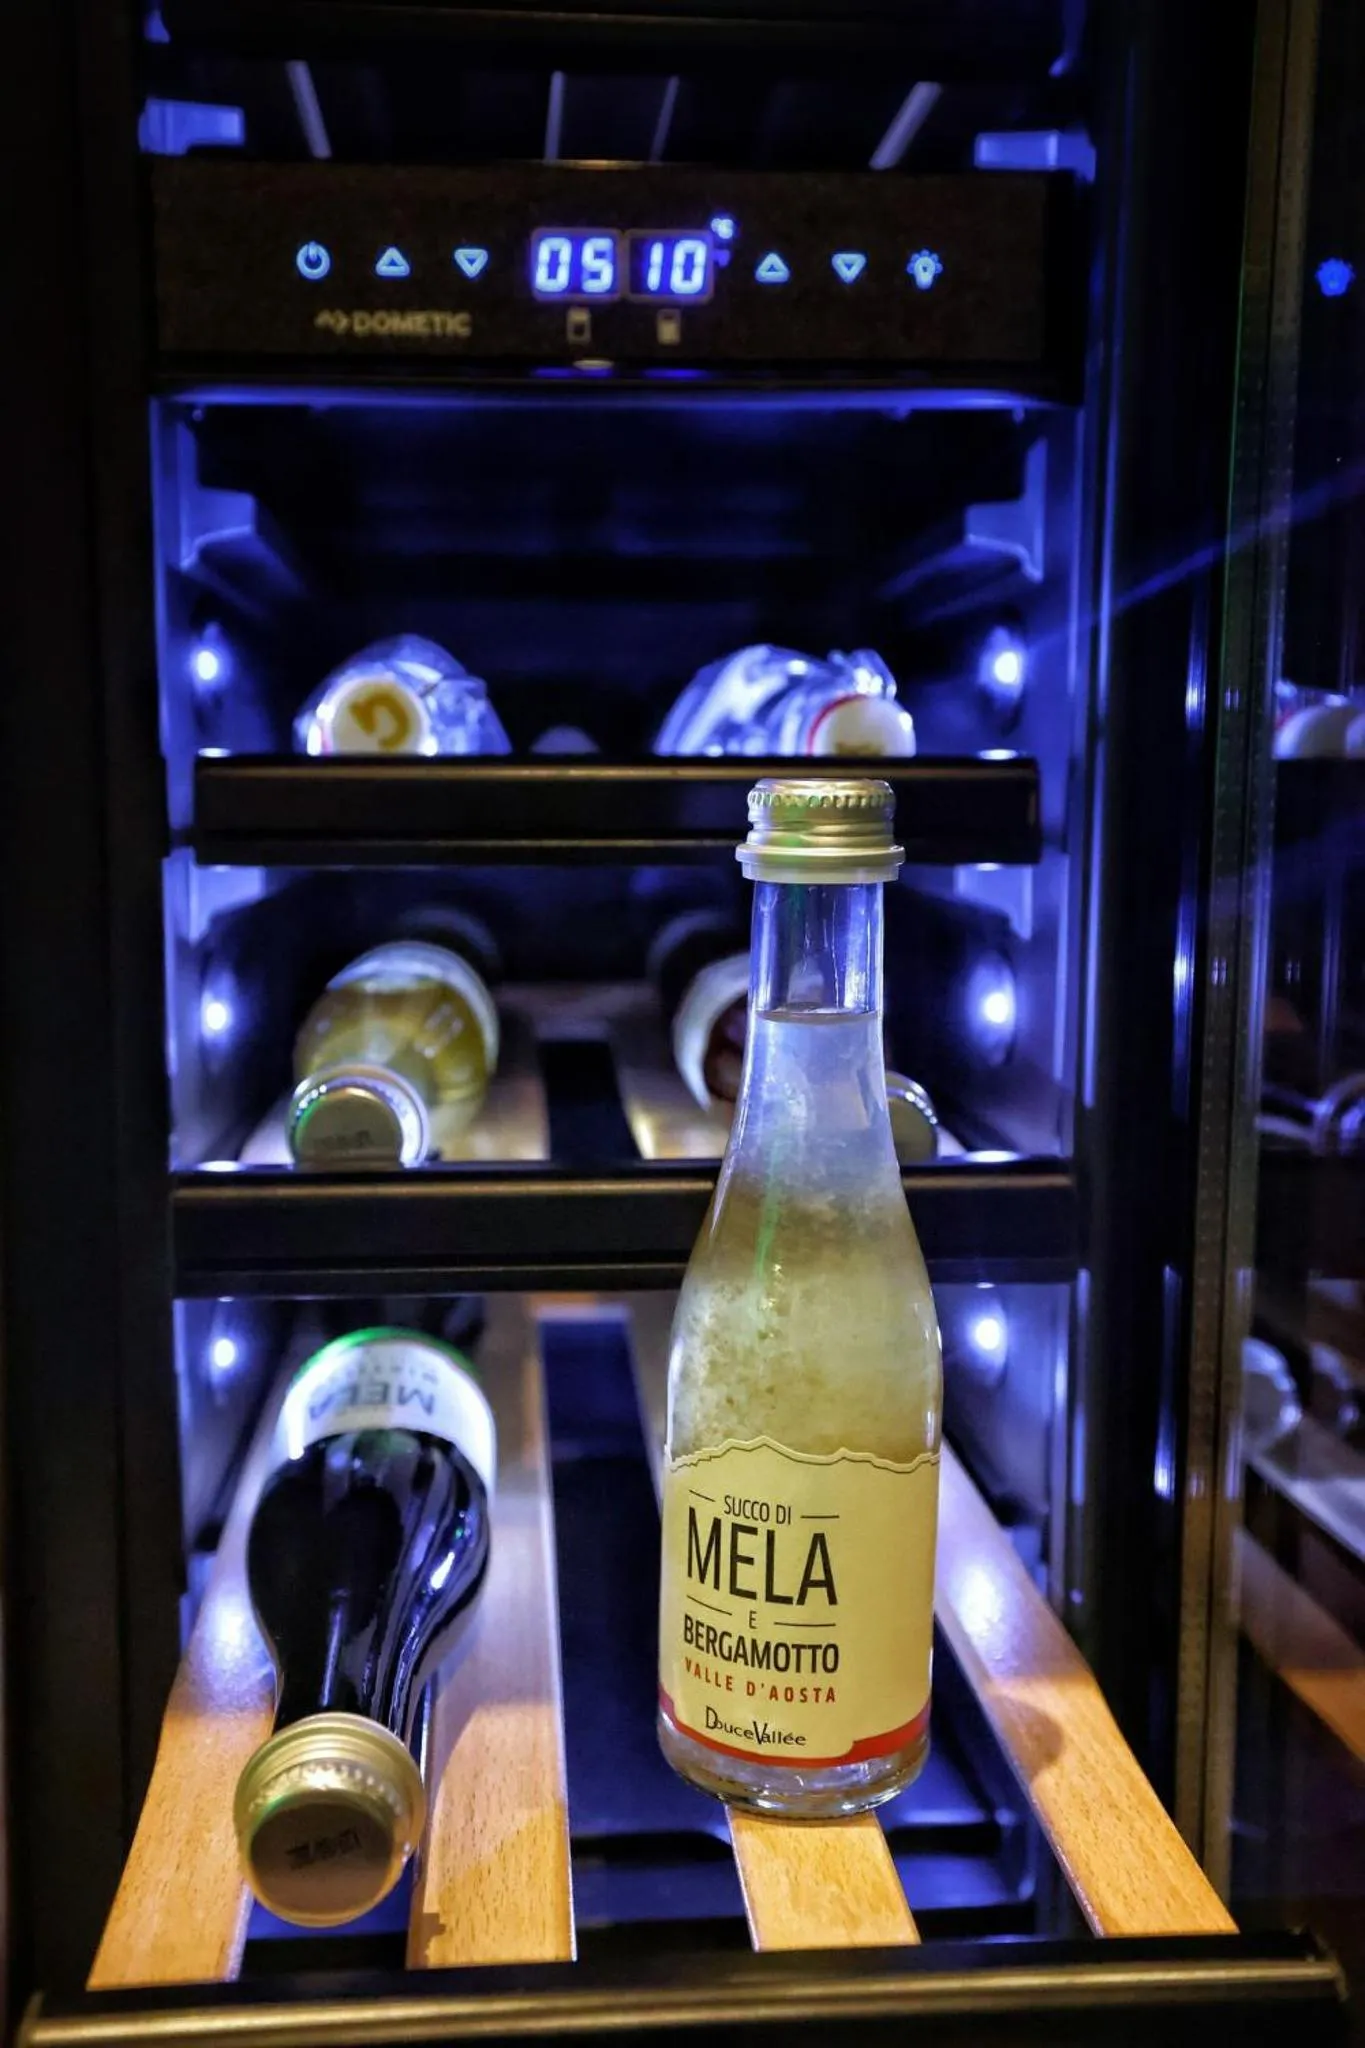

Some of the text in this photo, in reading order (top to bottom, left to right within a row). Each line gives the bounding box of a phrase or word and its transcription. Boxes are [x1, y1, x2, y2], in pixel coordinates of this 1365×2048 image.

[534, 236, 707, 294] 05 10
[352, 310, 472, 338] DOMETIC
[724, 1495, 791, 1525] SUCCO DI
[687, 1506, 838, 1606] MELA
[749, 1611, 757, 1629] E
[683, 1614, 840, 1673] BERGAMOTTO
[685, 1657, 836, 1703] VALLE D'AOSTA
